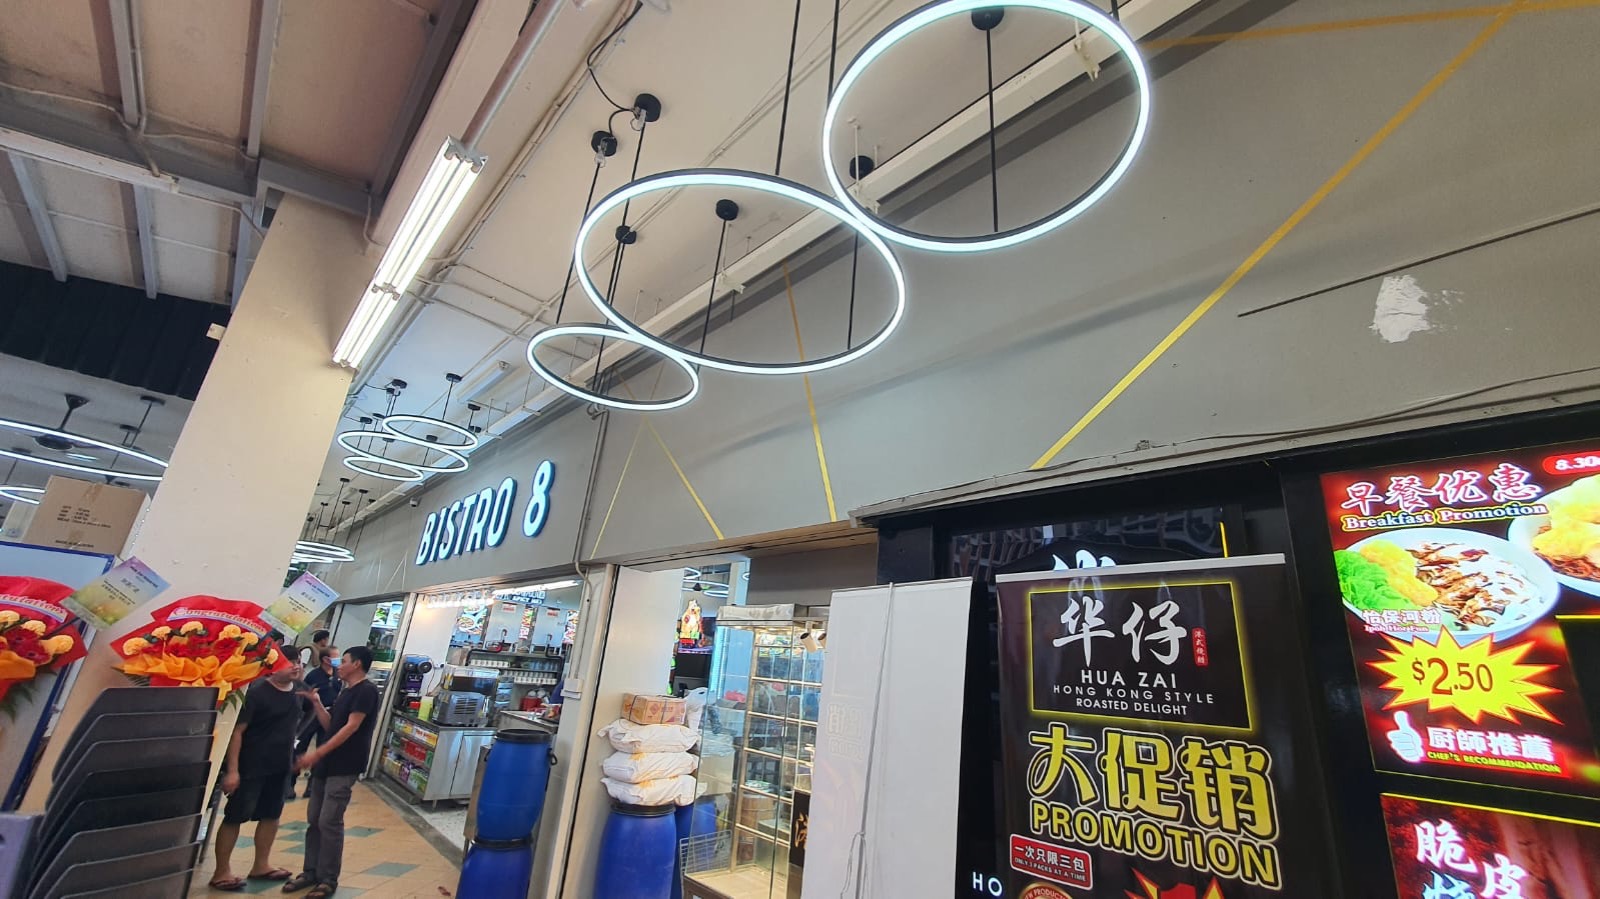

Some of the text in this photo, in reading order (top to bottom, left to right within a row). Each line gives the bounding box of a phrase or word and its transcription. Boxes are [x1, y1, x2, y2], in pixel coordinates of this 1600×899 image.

[1341, 463, 1542, 516] 早餐优惠
[415, 460, 556, 565] BISTRO 8
[1343, 503, 1548, 530] Breakfast Promotion
[1362, 607, 1441, 625] 怡保河粉
[1053, 596, 1187, 667] 华仔
[1081, 669, 1177, 689] HUA ZAI
[1411, 657, 1493, 696] $2.50
[1053, 685, 1214, 704] HONG KONG STYLE
[1076, 698, 1187, 715] ROASTED DELIGHT
[1427, 751, 1561, 773] CHEF'S RECOMMENDATION
[1028, 723, 1279, 839] 大促销
[1031, 800, 1281, 889] PROMOTION
[1015, 845, 1085, 872] 一次只限三包
[1015, 857, 1028, 865] ONLY
[1033, 862, 1052, 872] PACKS
[1071, 872, 1086, 881] TIME
